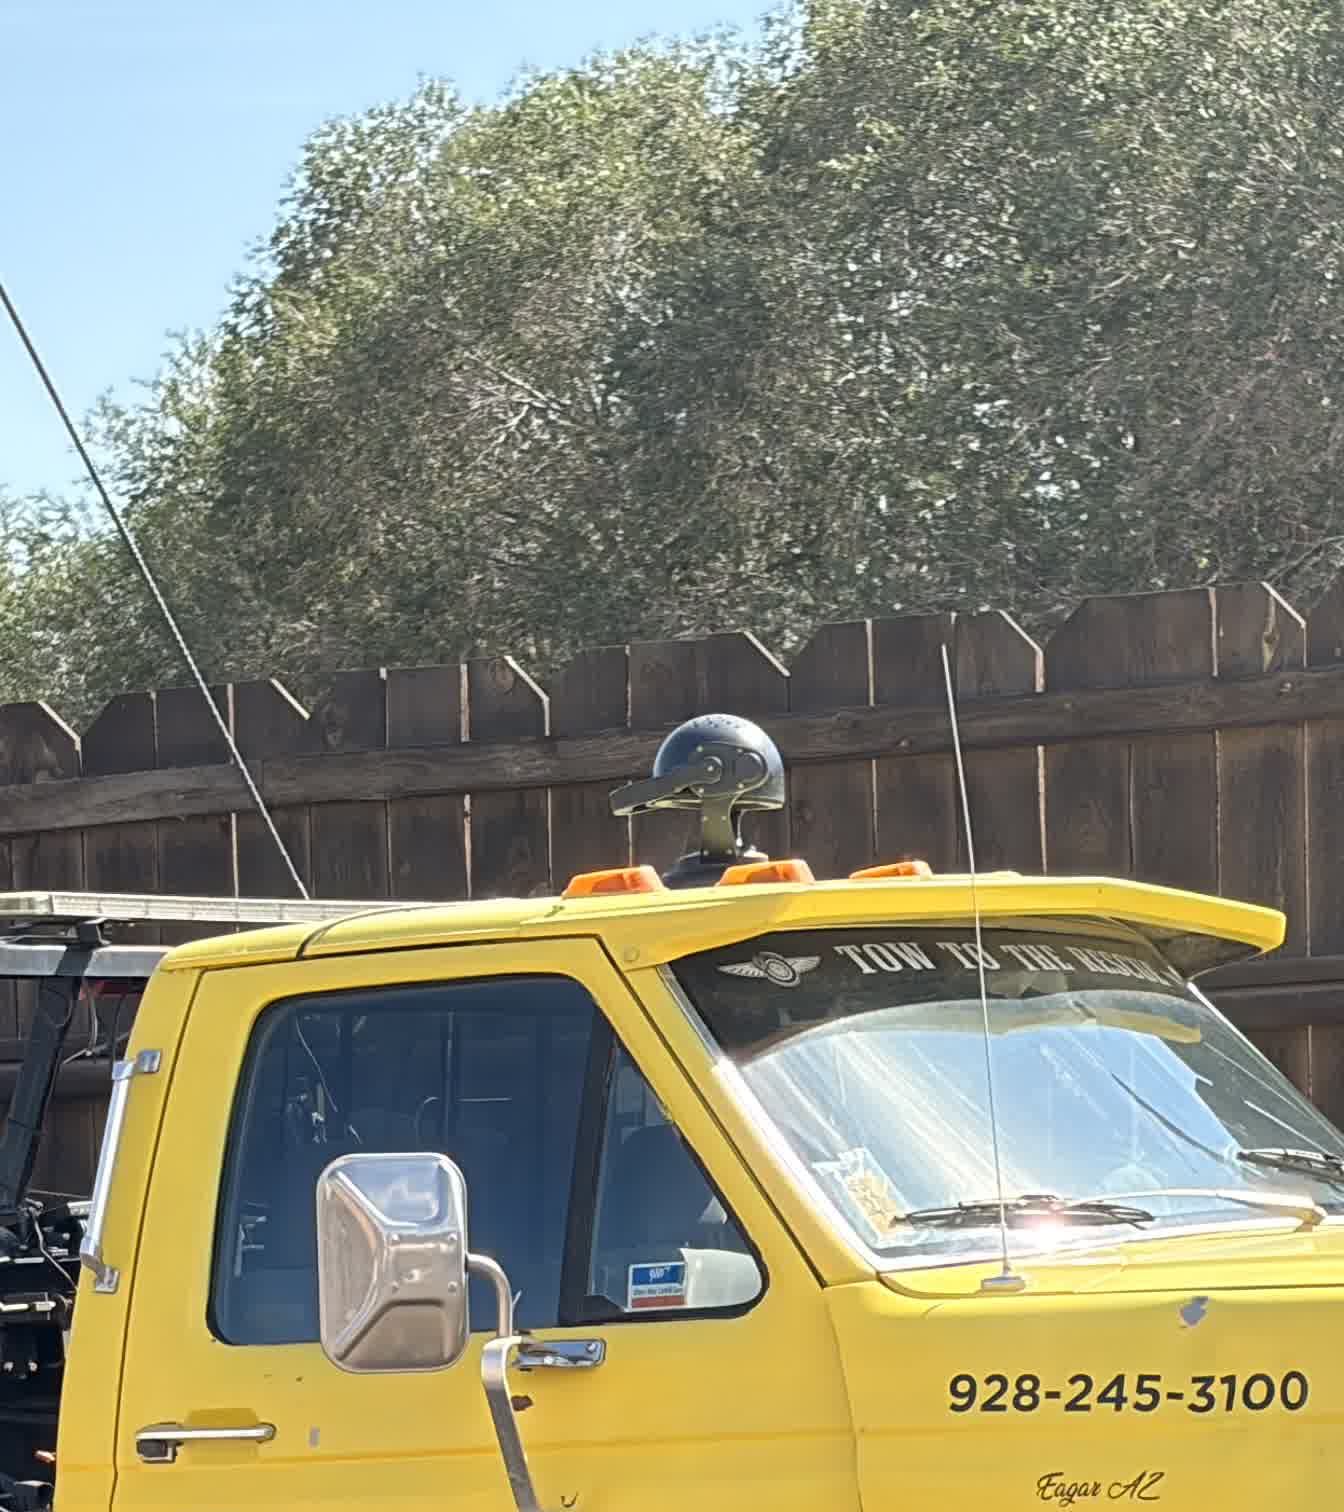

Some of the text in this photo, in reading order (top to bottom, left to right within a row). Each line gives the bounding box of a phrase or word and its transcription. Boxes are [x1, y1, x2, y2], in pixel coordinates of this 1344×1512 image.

[834, 942, 937, 974] TOW
[936, 941, 1001, 971] TO
[1000, 944, 1076, 972] THE
[948, 1371, 1309, 1413] 928-245-3100
[1036, 1470, 1165, 1508] Eagar AZ
